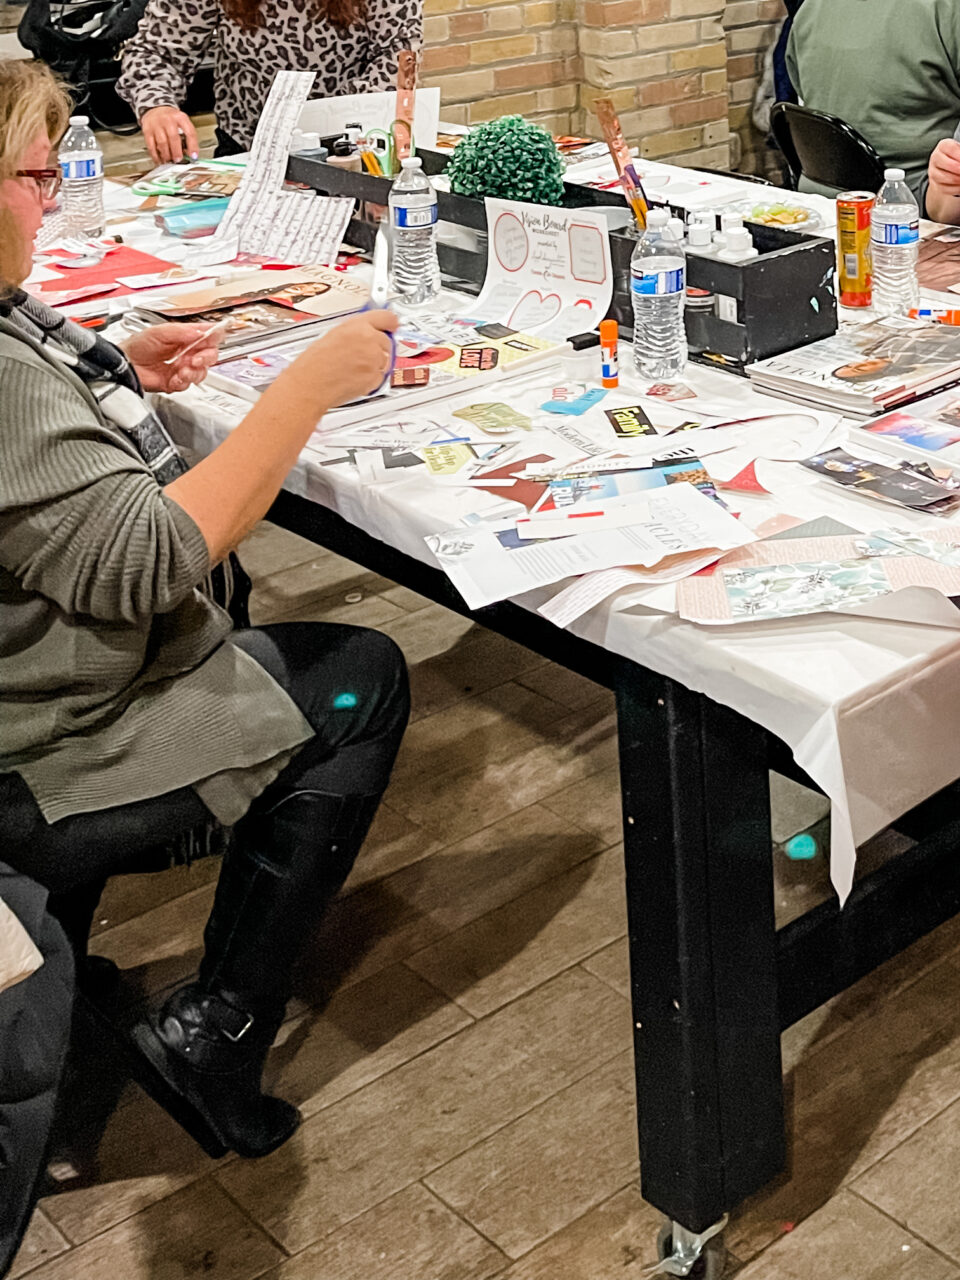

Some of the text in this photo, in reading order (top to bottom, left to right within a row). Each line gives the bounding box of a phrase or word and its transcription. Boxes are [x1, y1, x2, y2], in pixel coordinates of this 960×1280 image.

[301, 266, 370, 297] MAGNOL
[460, 349, 481, 368] LOVE
[612, 406, 651, 437] Family
